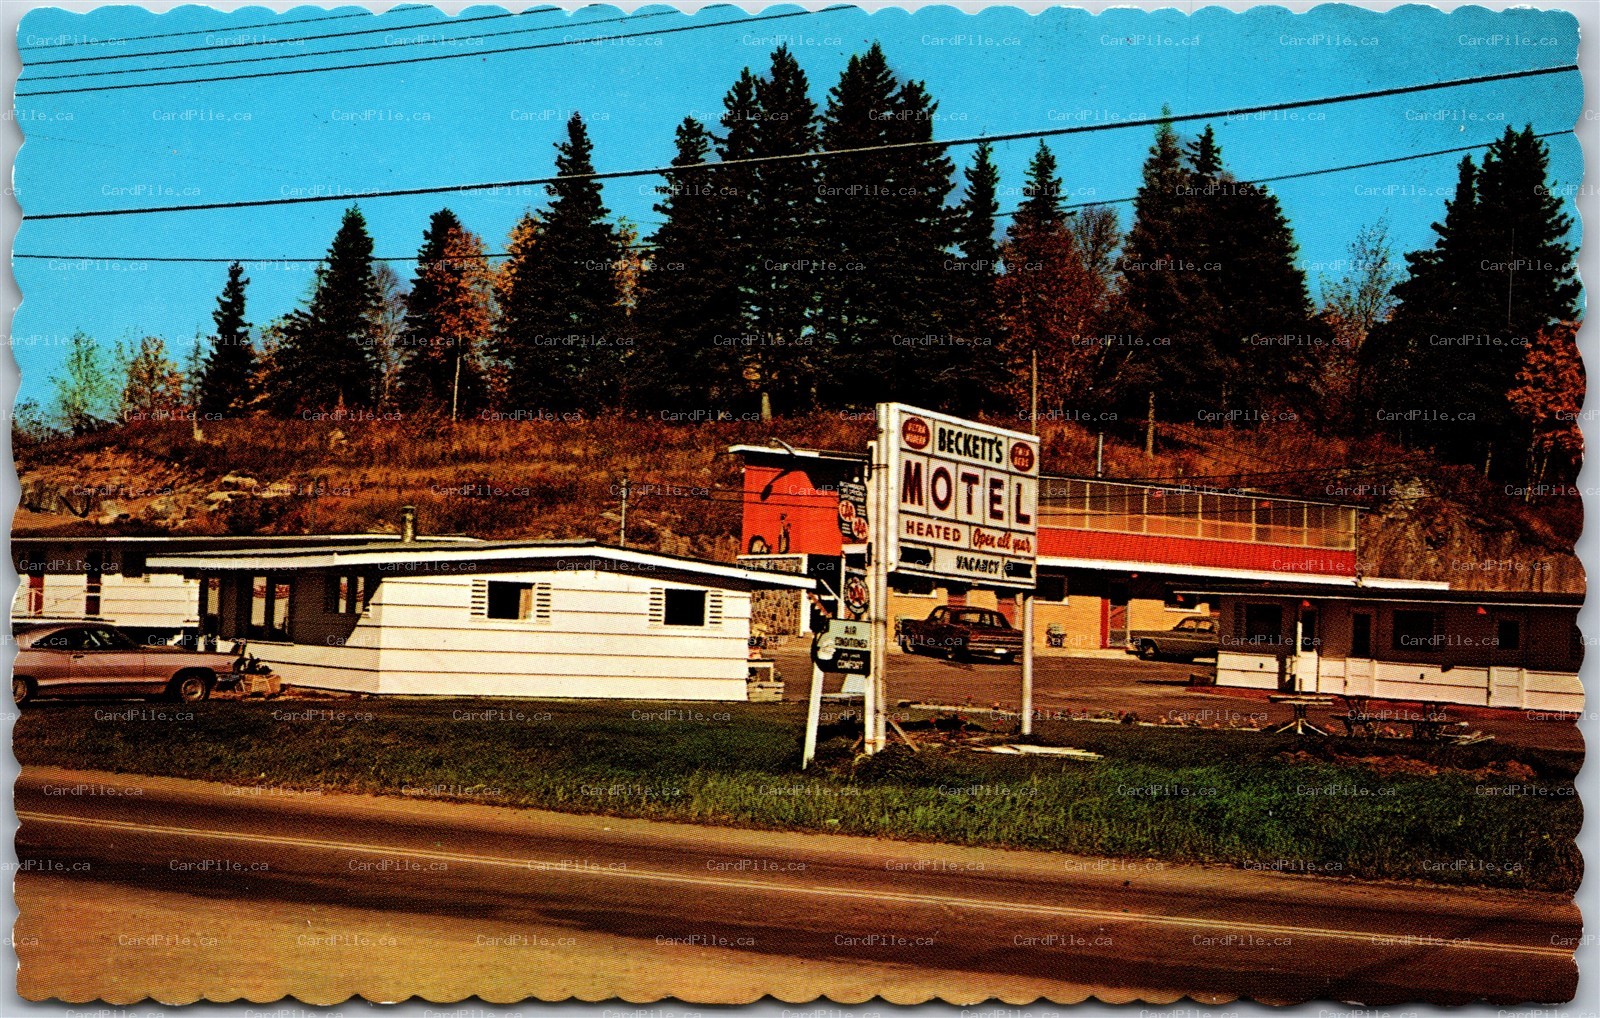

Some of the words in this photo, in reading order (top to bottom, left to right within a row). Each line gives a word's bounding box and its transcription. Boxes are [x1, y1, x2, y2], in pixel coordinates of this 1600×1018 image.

[938, 428, 1003, 463] BECKETT'S
[901, 459, 1031, 526] MOTEL
[906, 520, 962, 542] HEATED
[973, 527, 996, 550] Open
[997, 531, 1011, 549] all
[1012, 536, 1031, 554] year
[956, 555, 1000, 574] VACANCY
[844, 625, 857, 635] AIR
